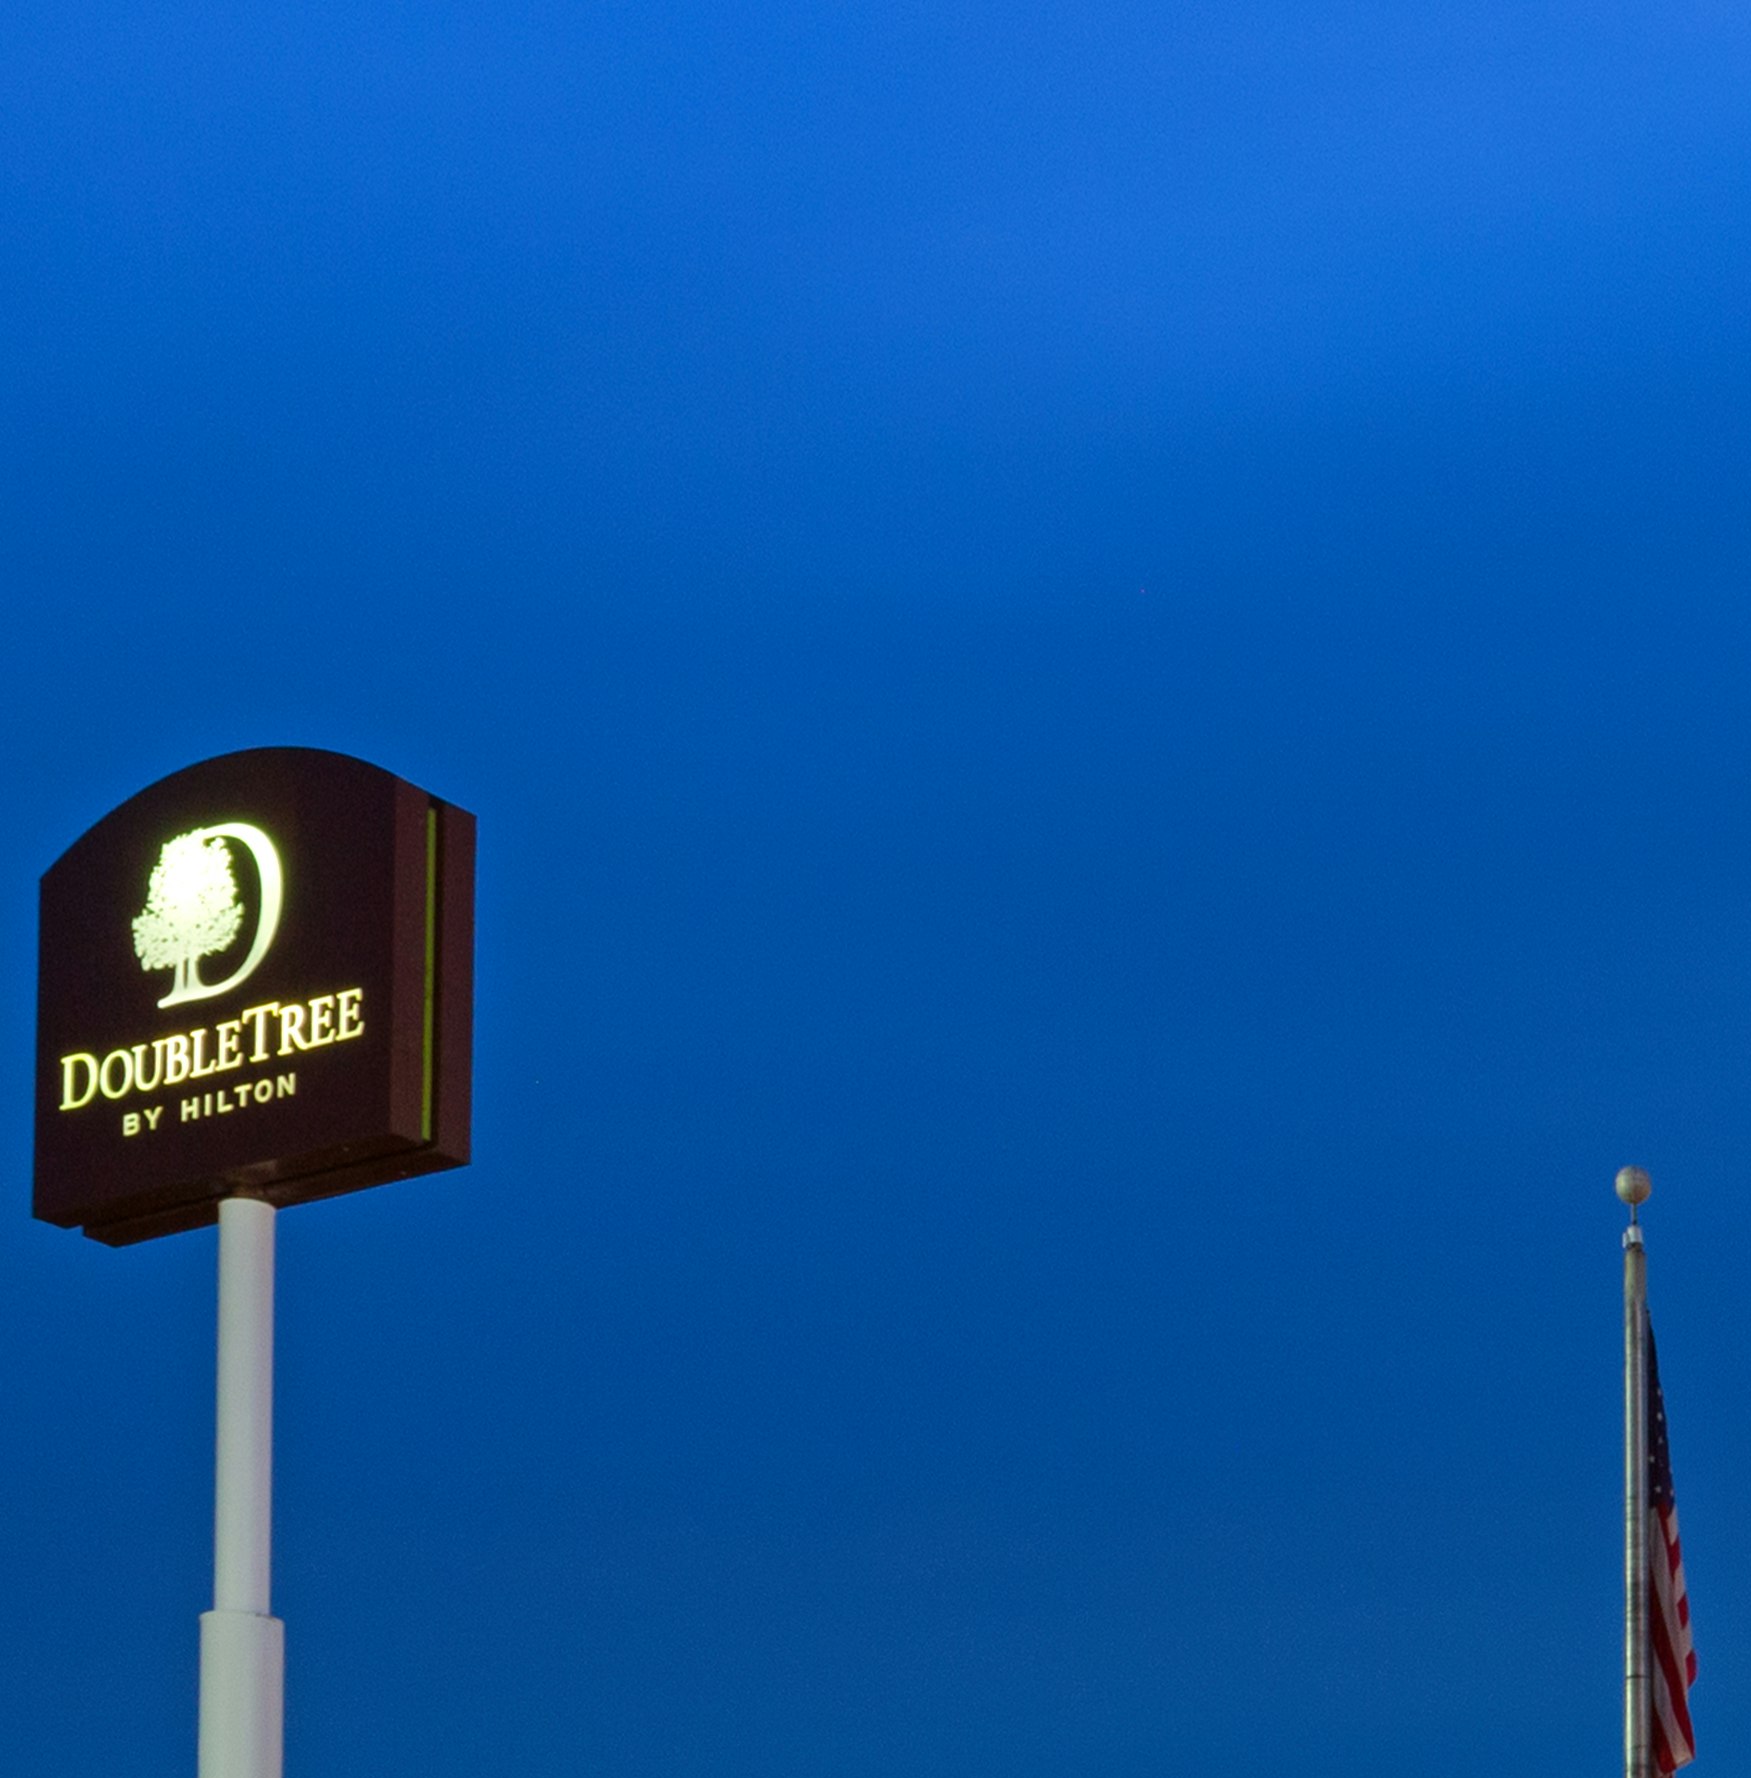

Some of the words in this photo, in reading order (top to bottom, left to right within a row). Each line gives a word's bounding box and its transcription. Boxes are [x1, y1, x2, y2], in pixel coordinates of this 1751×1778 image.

[59, 988, 365, 1110] DOUBLETREE
[122, 1107, 163, 1137] BY
[181, 1073, 297, 1122] HILTON
